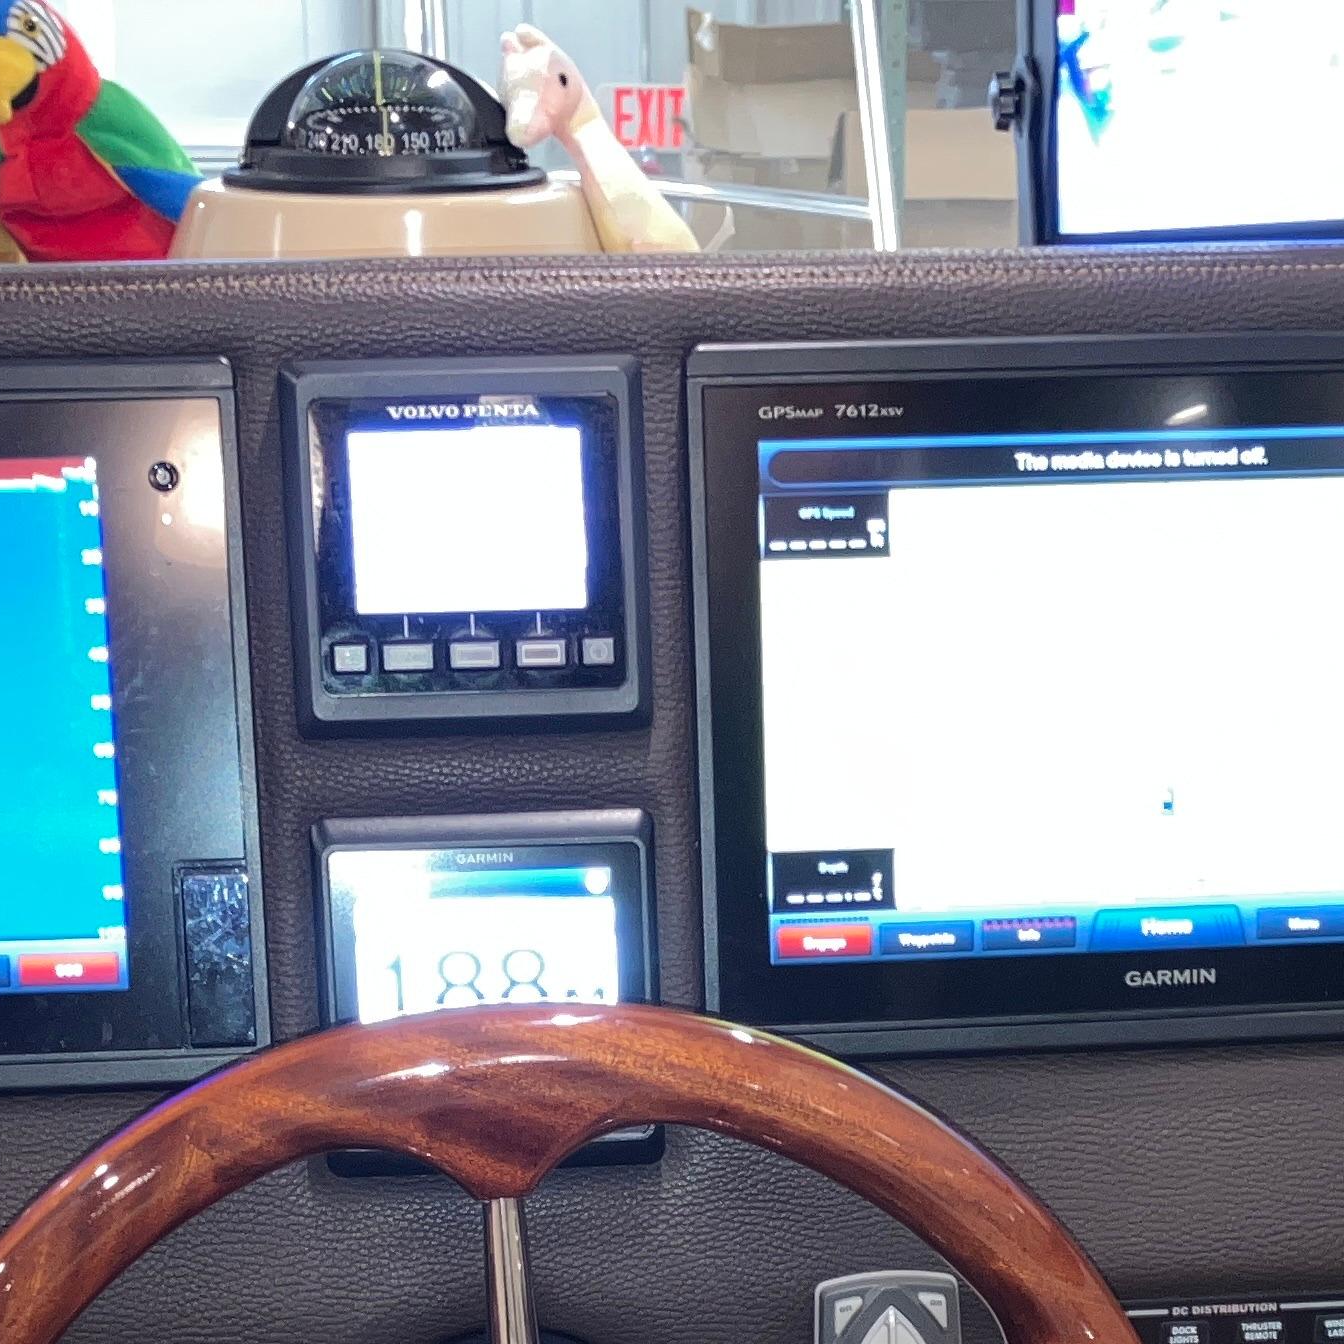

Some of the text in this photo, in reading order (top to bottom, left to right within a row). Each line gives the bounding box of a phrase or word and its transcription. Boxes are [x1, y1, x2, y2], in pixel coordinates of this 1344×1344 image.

[613, 87, 685, 148] EXIT
[402, 132, 429, 149] 150
[386, 403, 539, 419] VOLVO PENTA
[1014, 452, 1048, 471] The
[1051, 451, 1105, 470] media
[1183, 447, 1238, 467] turned
[456, 852, 514, 865] GARMIN
[1125, 968, 1216, 988] GARMIN
[1172, 1302, 1278, 1316] DC DISTRIBUTION
